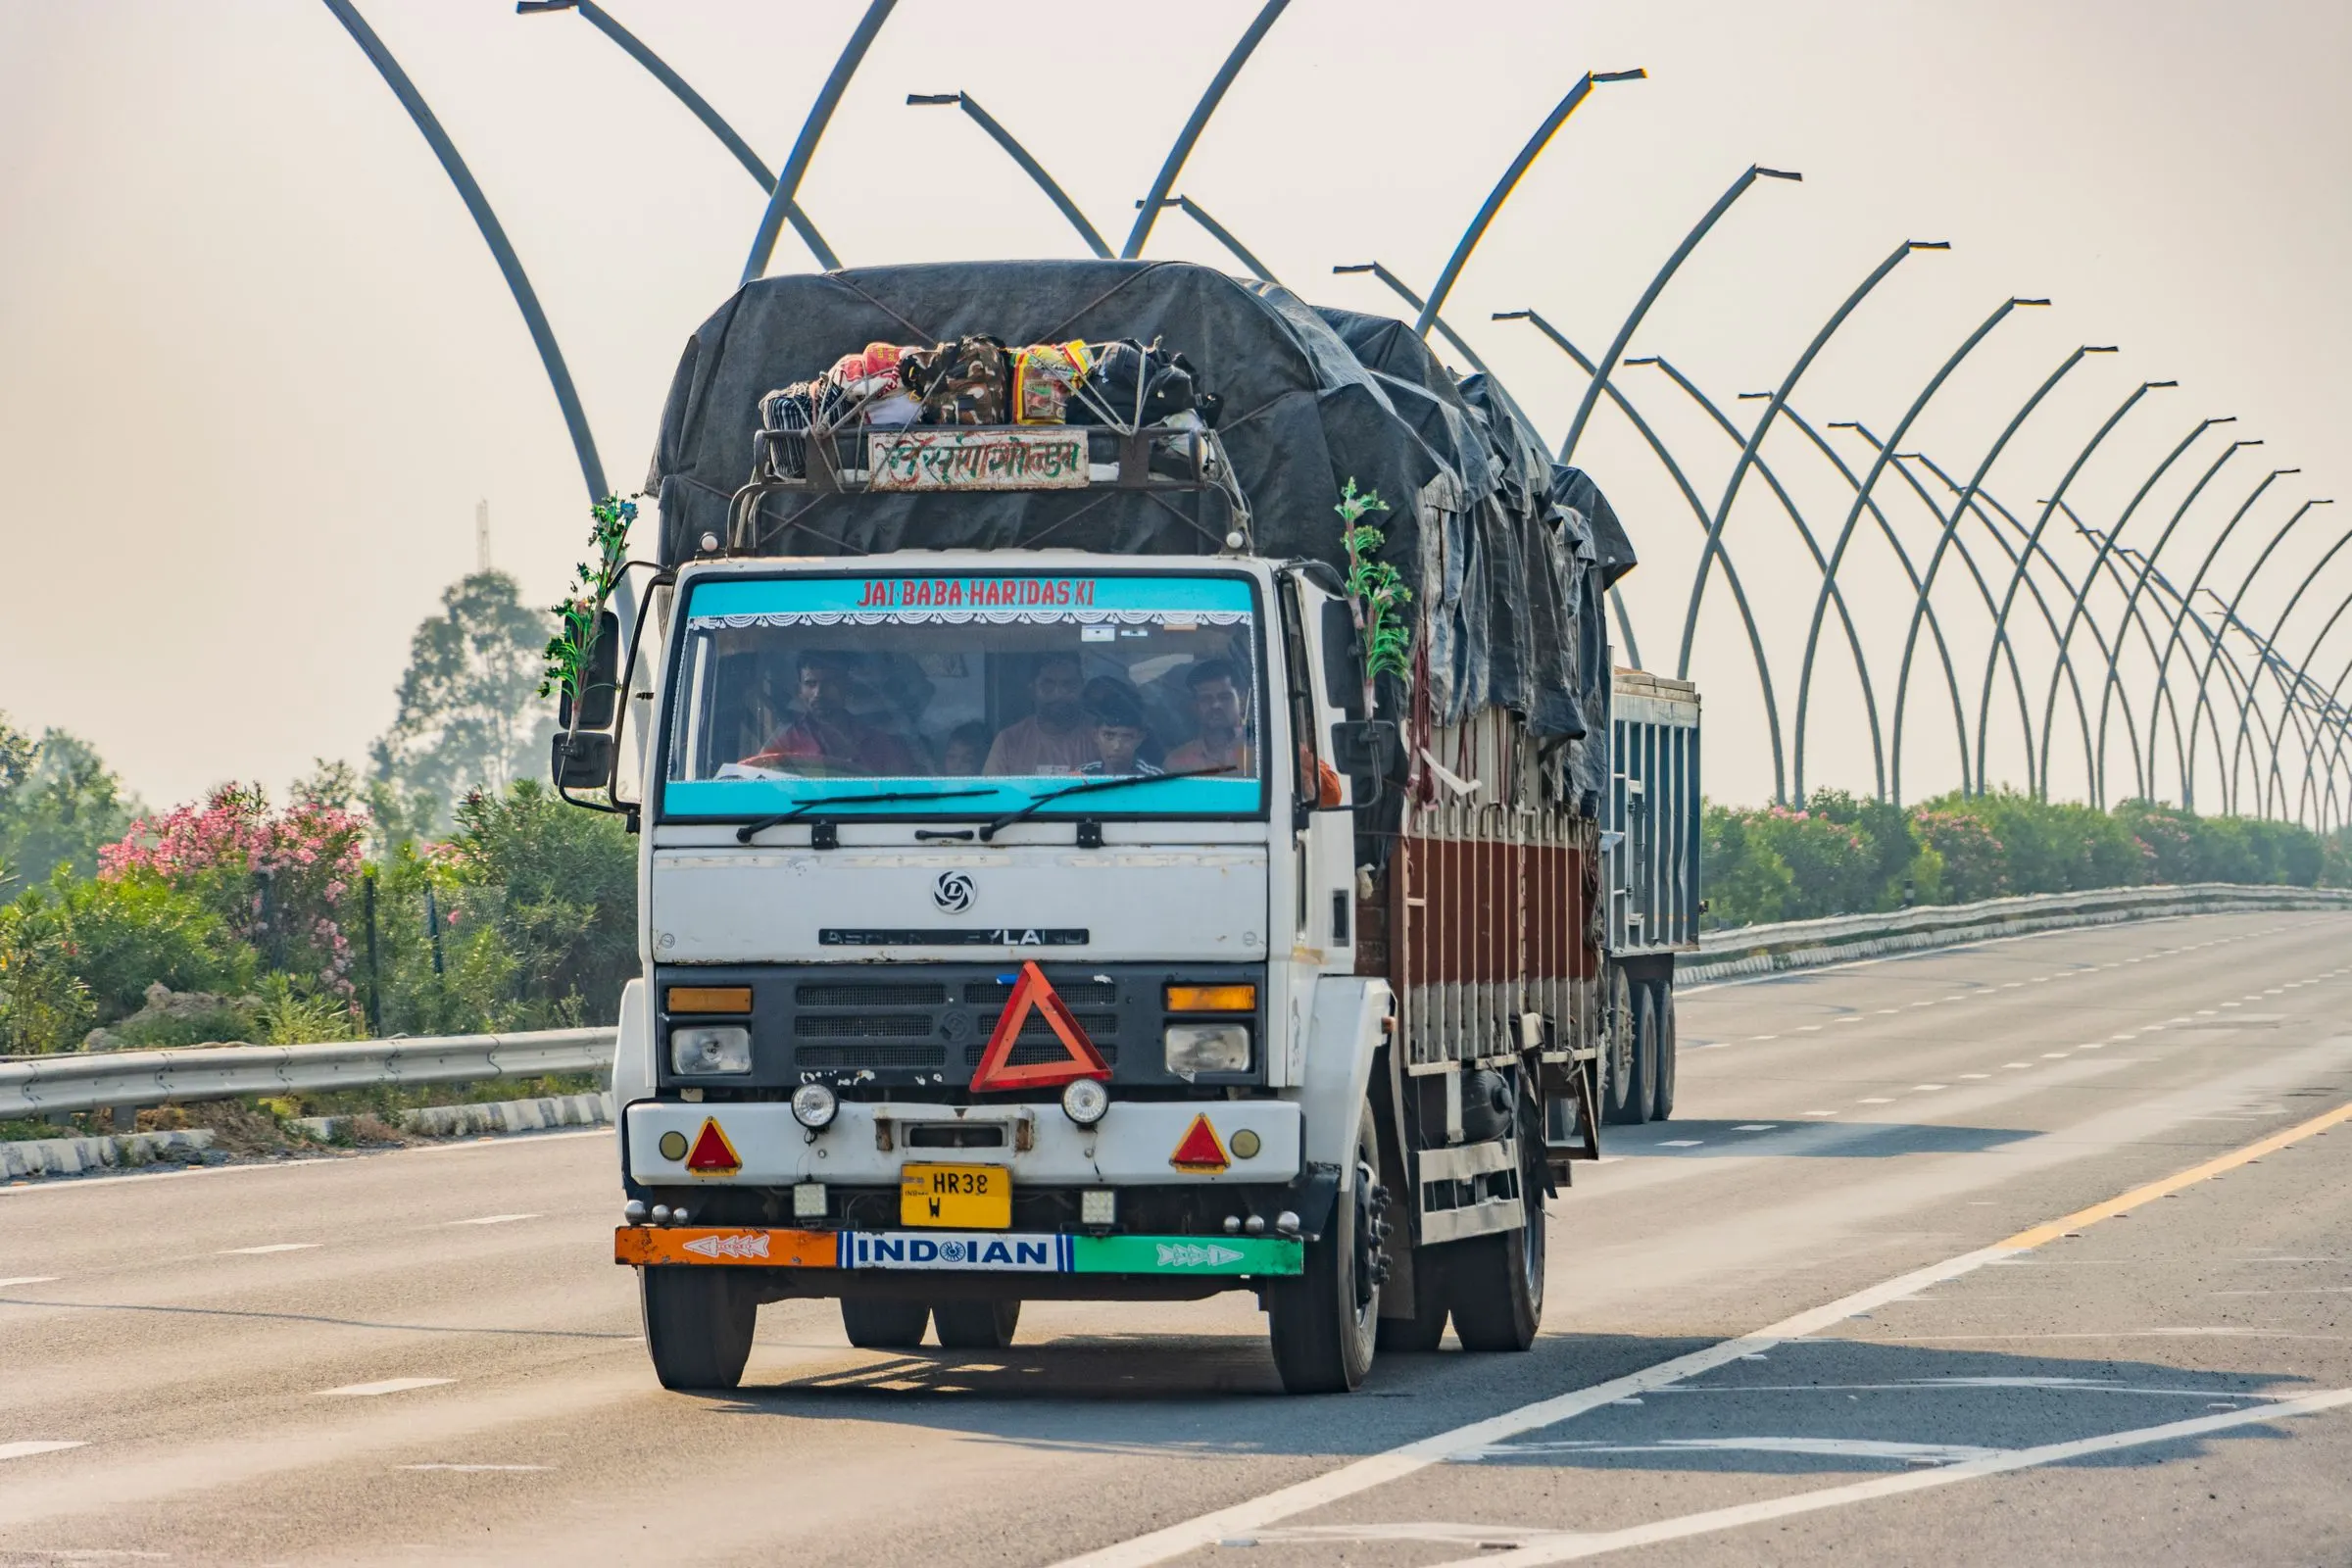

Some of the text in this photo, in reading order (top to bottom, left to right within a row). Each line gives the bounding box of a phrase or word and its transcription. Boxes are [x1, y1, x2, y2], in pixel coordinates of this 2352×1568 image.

[857, 580, 1096, 607] JAI BABA HARIDAS KI
[933, 1172, 988, 1195] HR38
